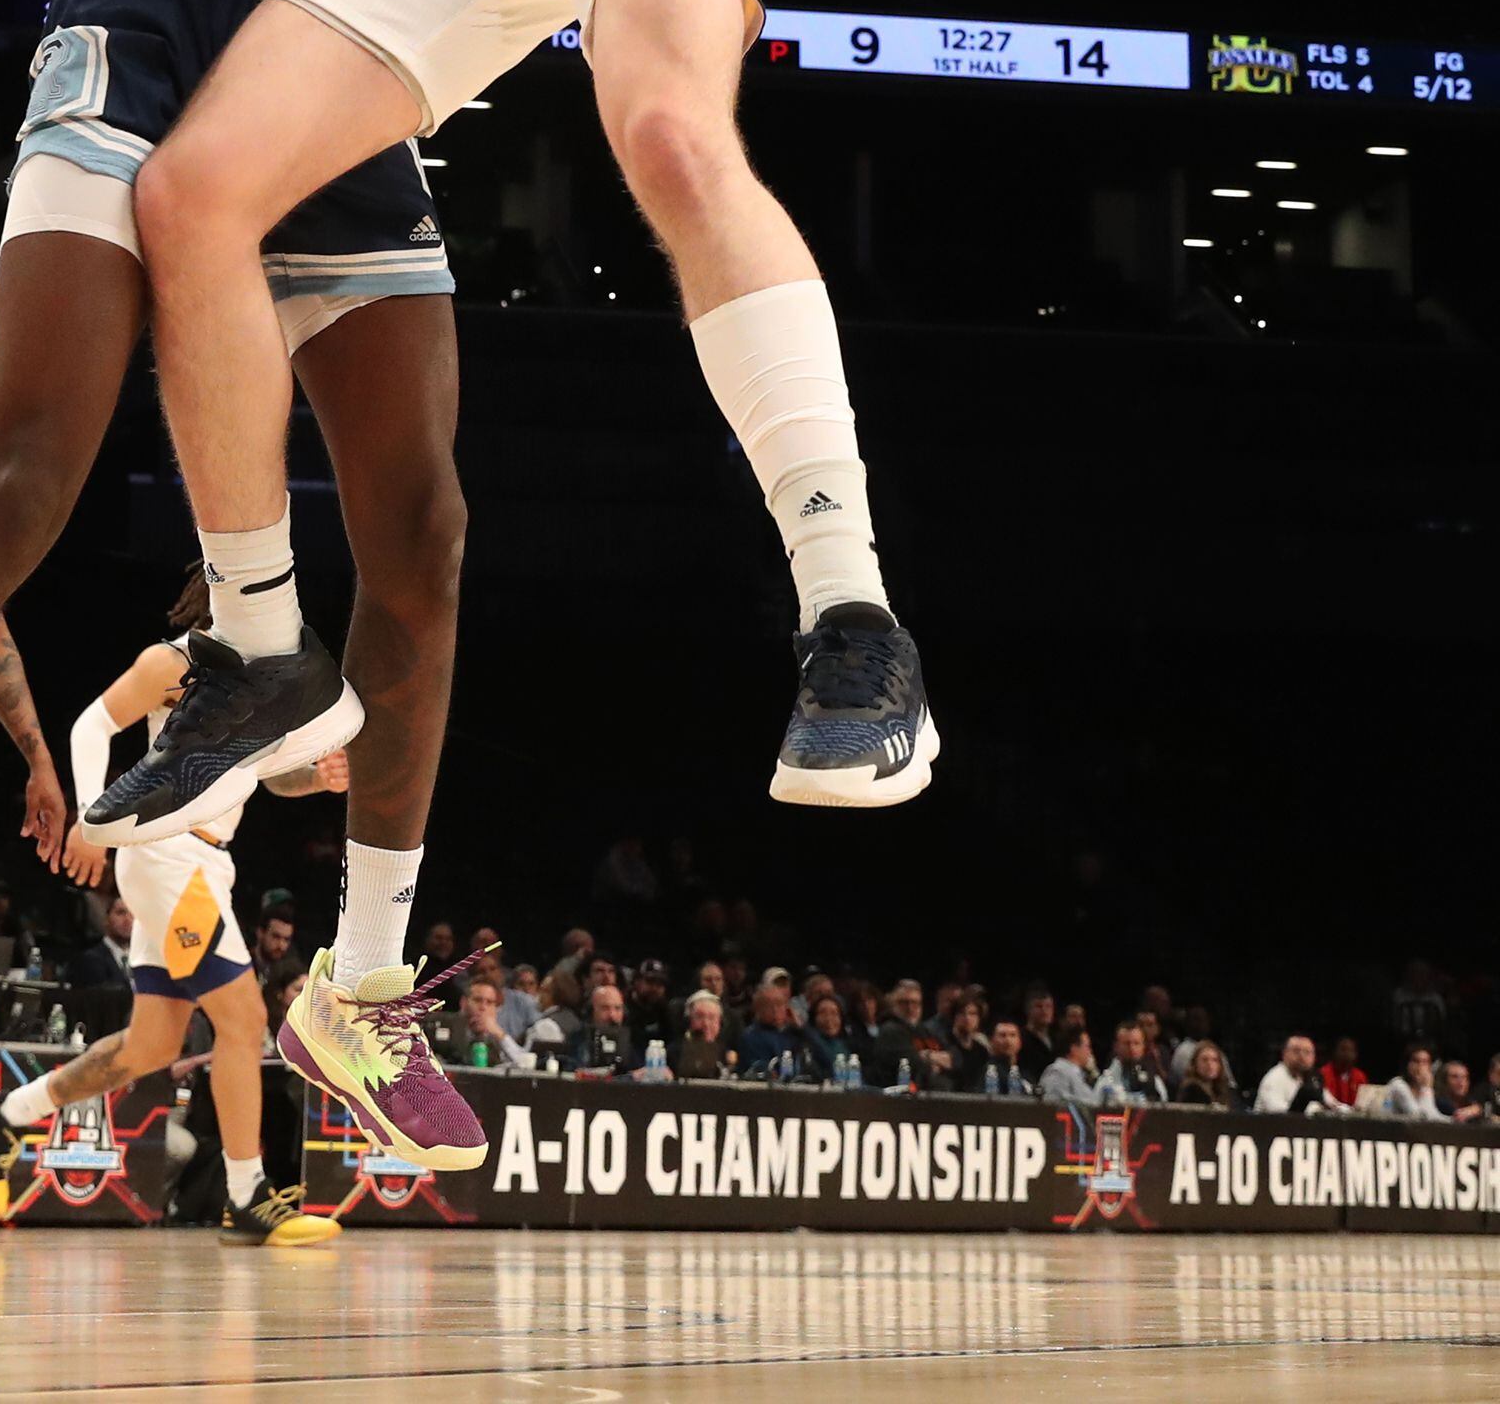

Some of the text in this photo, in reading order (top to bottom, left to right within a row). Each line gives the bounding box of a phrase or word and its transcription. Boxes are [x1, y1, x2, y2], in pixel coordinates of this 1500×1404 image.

[768, 40, 789, 63] P
[850, 27, 880, 65] 9
[939, 28, 1012, 53] 12:27
[933, 57, 1018, 76] 1ST HALF
[1054, 38, 1110, 78] 14
[1306, 43, 1370, 67] FLS 5
[1433, 51, 1465, 72] FG
[1306, 69, 1374, 94] TOL 4
[1412, 74, 1473, 103] 5/12
[409, 230, 441, 242] adidas
[800, 501, 843, 518] adidas
[492, 1104, 1047, 1206] A-10 CHAMPIONSHIP
[1169, 1132, 1259, 1206] A-10
